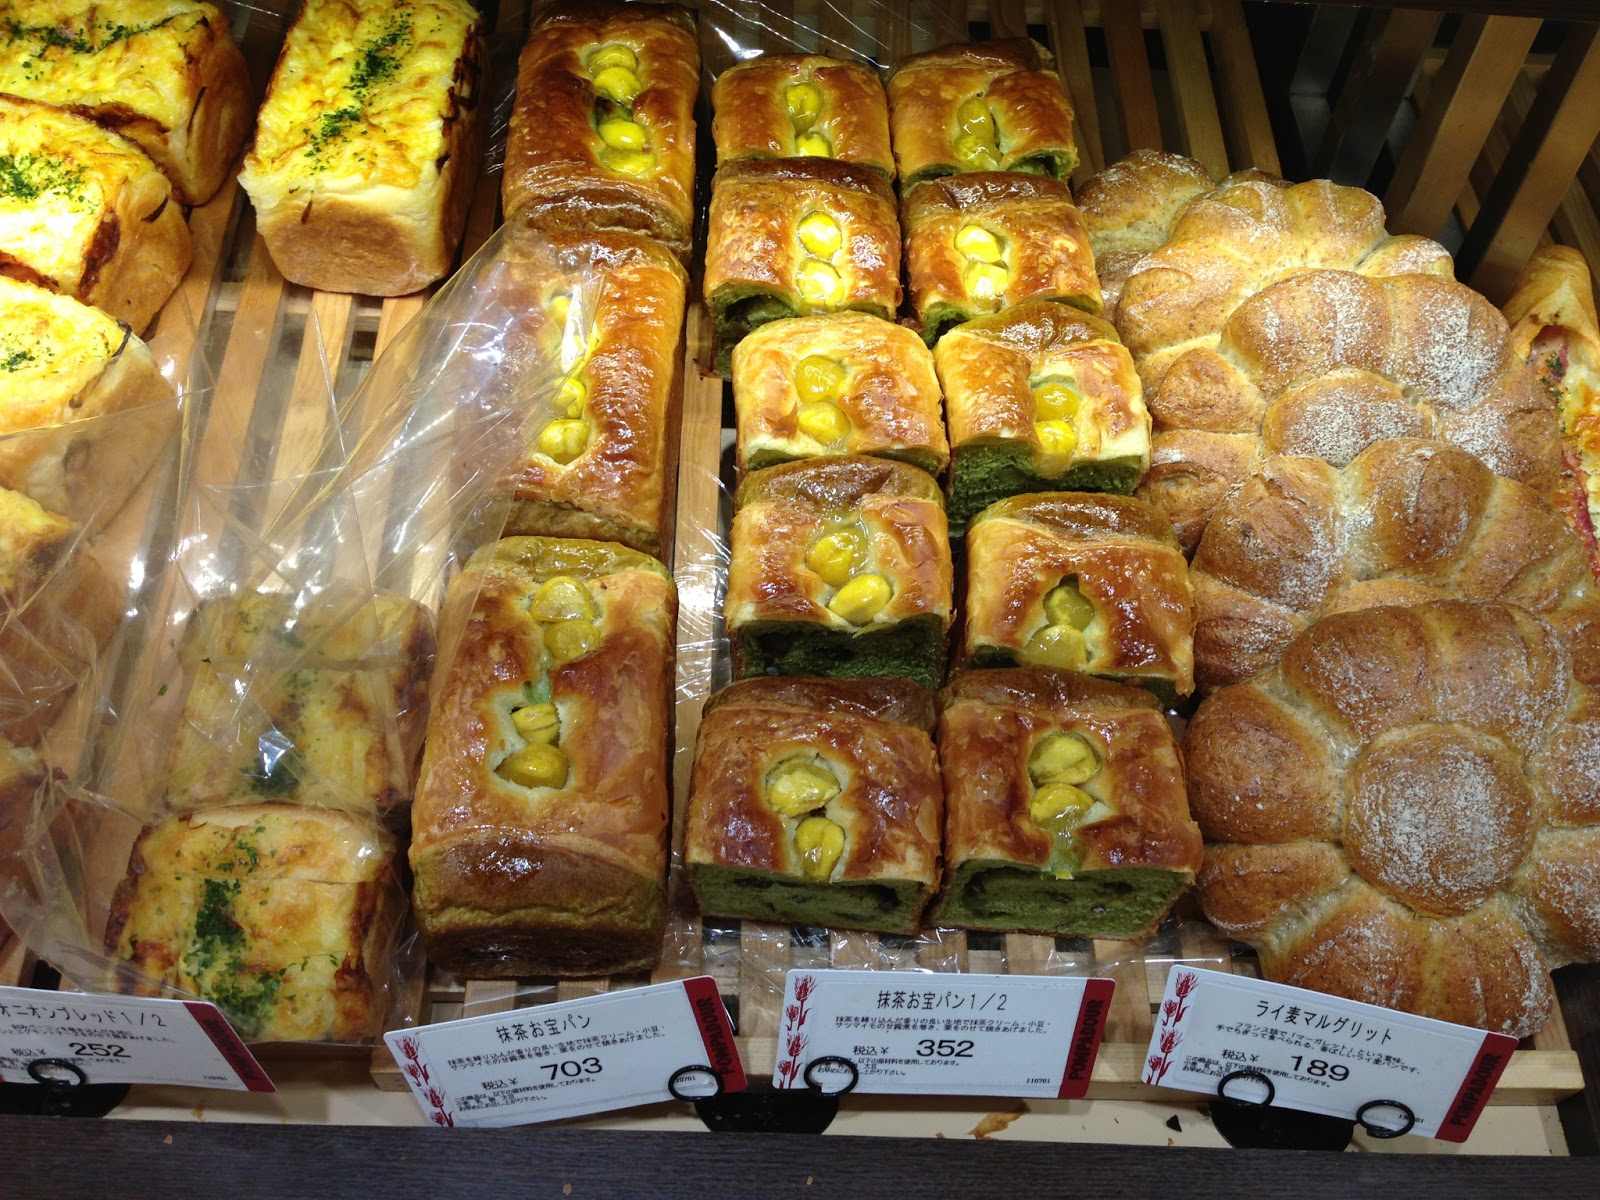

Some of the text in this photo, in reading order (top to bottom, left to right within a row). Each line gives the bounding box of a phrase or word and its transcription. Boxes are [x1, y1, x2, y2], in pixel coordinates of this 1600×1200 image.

[496, 1013, 591, 1044] 抹茶お宝パン
[1256, 1000, 1392, 1045] ライ麦マルグリット
[69, 1042, 131, 1058] 252
[916, 1039, 974, 1058] 352
[540, 1057, 603, 1080] 703
[1291, 1055, 1350, 1081] 189
